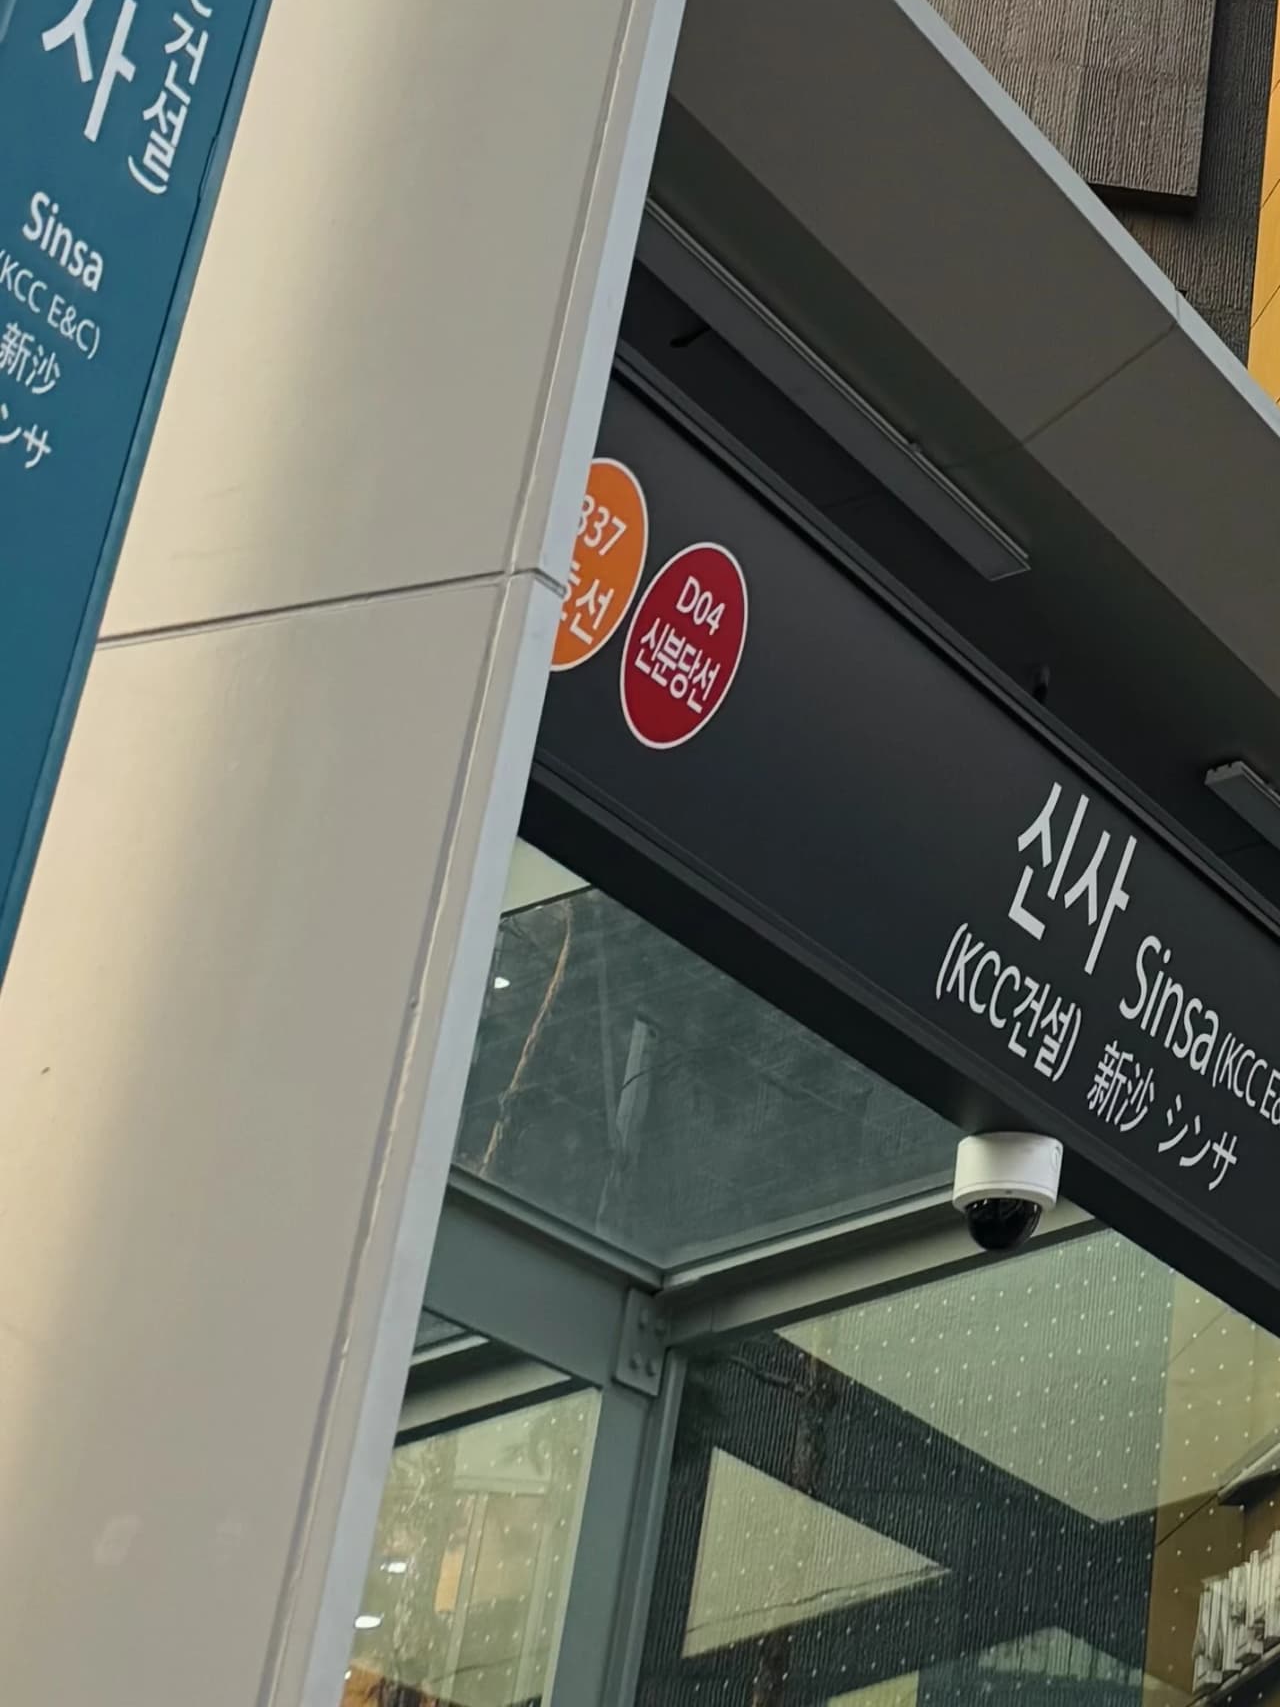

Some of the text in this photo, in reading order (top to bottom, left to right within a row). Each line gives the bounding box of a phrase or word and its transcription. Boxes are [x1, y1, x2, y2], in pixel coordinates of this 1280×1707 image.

[23, 191, 104, 292] Sinsa
[0, 322, 61, 395] 新沙
[47, 294, 101, 360] E&C)
[676, 575, 727, 636] D04
[634, 617, 721, 714] 신분당선
[1008, 781, 1138, 976] 신사
[1119, 935, 1220, 1073] Sinsa
[935, 923, 1239, 1191] (KCC건설) 新沙 シンサ
